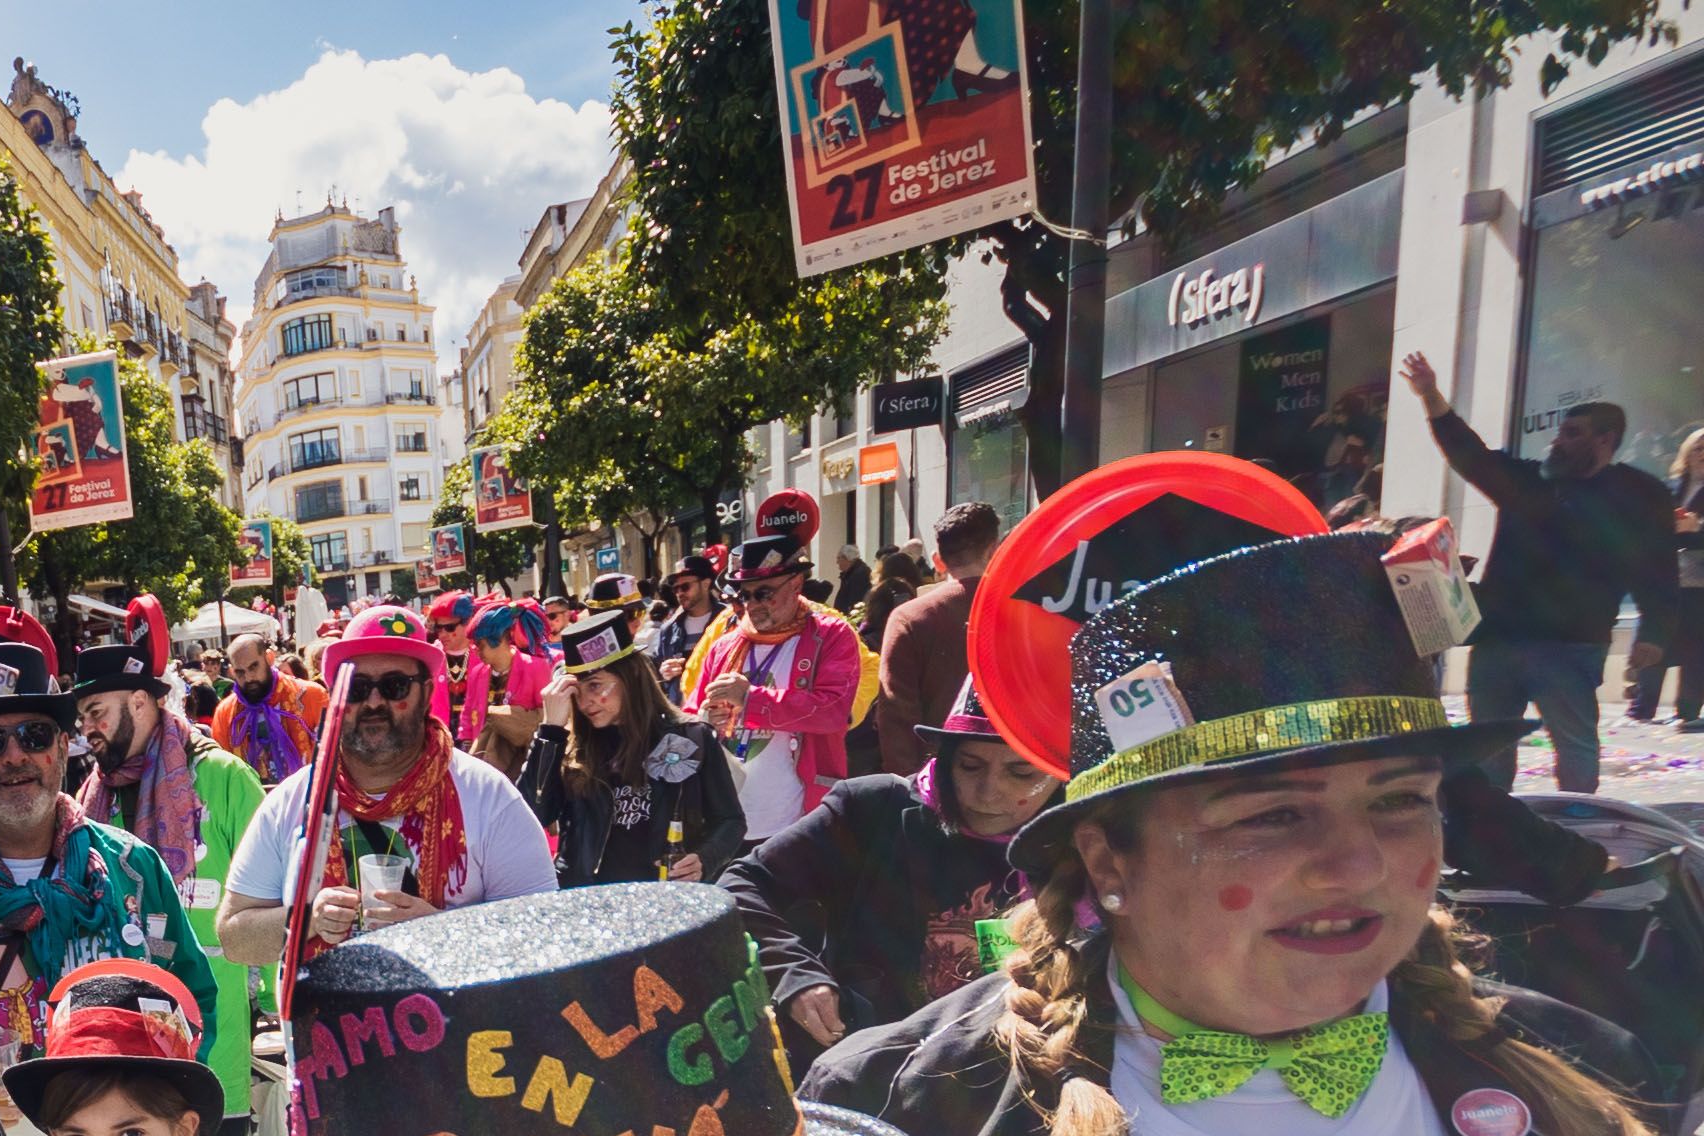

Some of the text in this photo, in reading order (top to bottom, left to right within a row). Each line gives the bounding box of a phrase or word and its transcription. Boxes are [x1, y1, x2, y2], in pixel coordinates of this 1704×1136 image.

[826, 161, 885, 230] 27
[887, 138, 986, 186] Festival
[889, 182, 922, 205] de
[927, 159, 996, 194] Jerez
[1249, 349, 1323, 372] Women
[1280, 371, 1321, 389] Men
[1275, 390, 1321, 413] Kids
[43, 479, 111, 510] 27 Festival
[86, 489, 115, 501] Jerez
[760, 510, 808, 528] Juanelo
[1109, 678, 1156, 718] 50
[465, 1030, 595, 1127] EN
[561, 964, 685, 1060] LA
[1460, 1104, 1518, 1121] Juanelo
